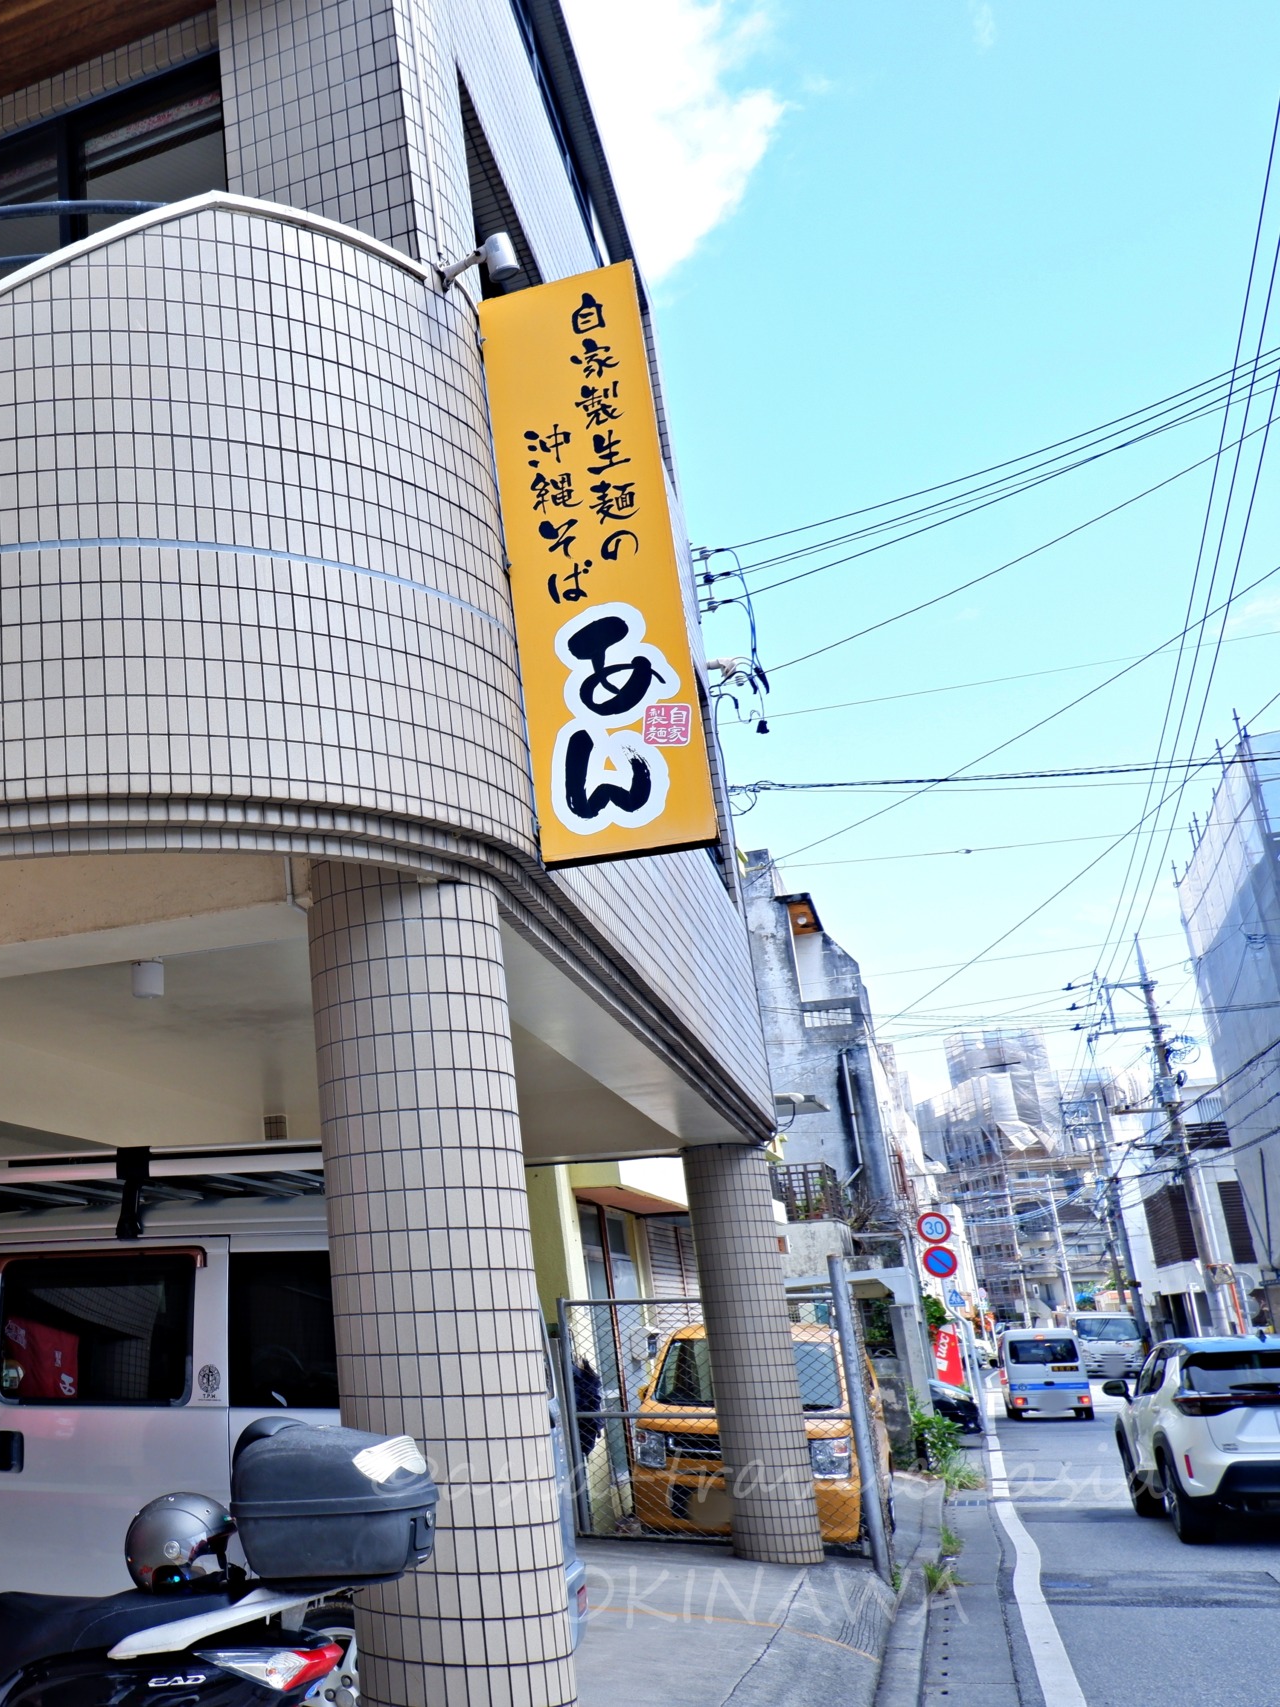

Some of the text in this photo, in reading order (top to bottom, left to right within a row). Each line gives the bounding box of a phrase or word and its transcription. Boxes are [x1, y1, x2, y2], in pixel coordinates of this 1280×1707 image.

[523, 424, 593, 604] 沖縄そば
[570, 292, 641, 561] 自家製生麺の
[565, 615, 667, 821] あん
[924, 1221, 945, 1236] 30
